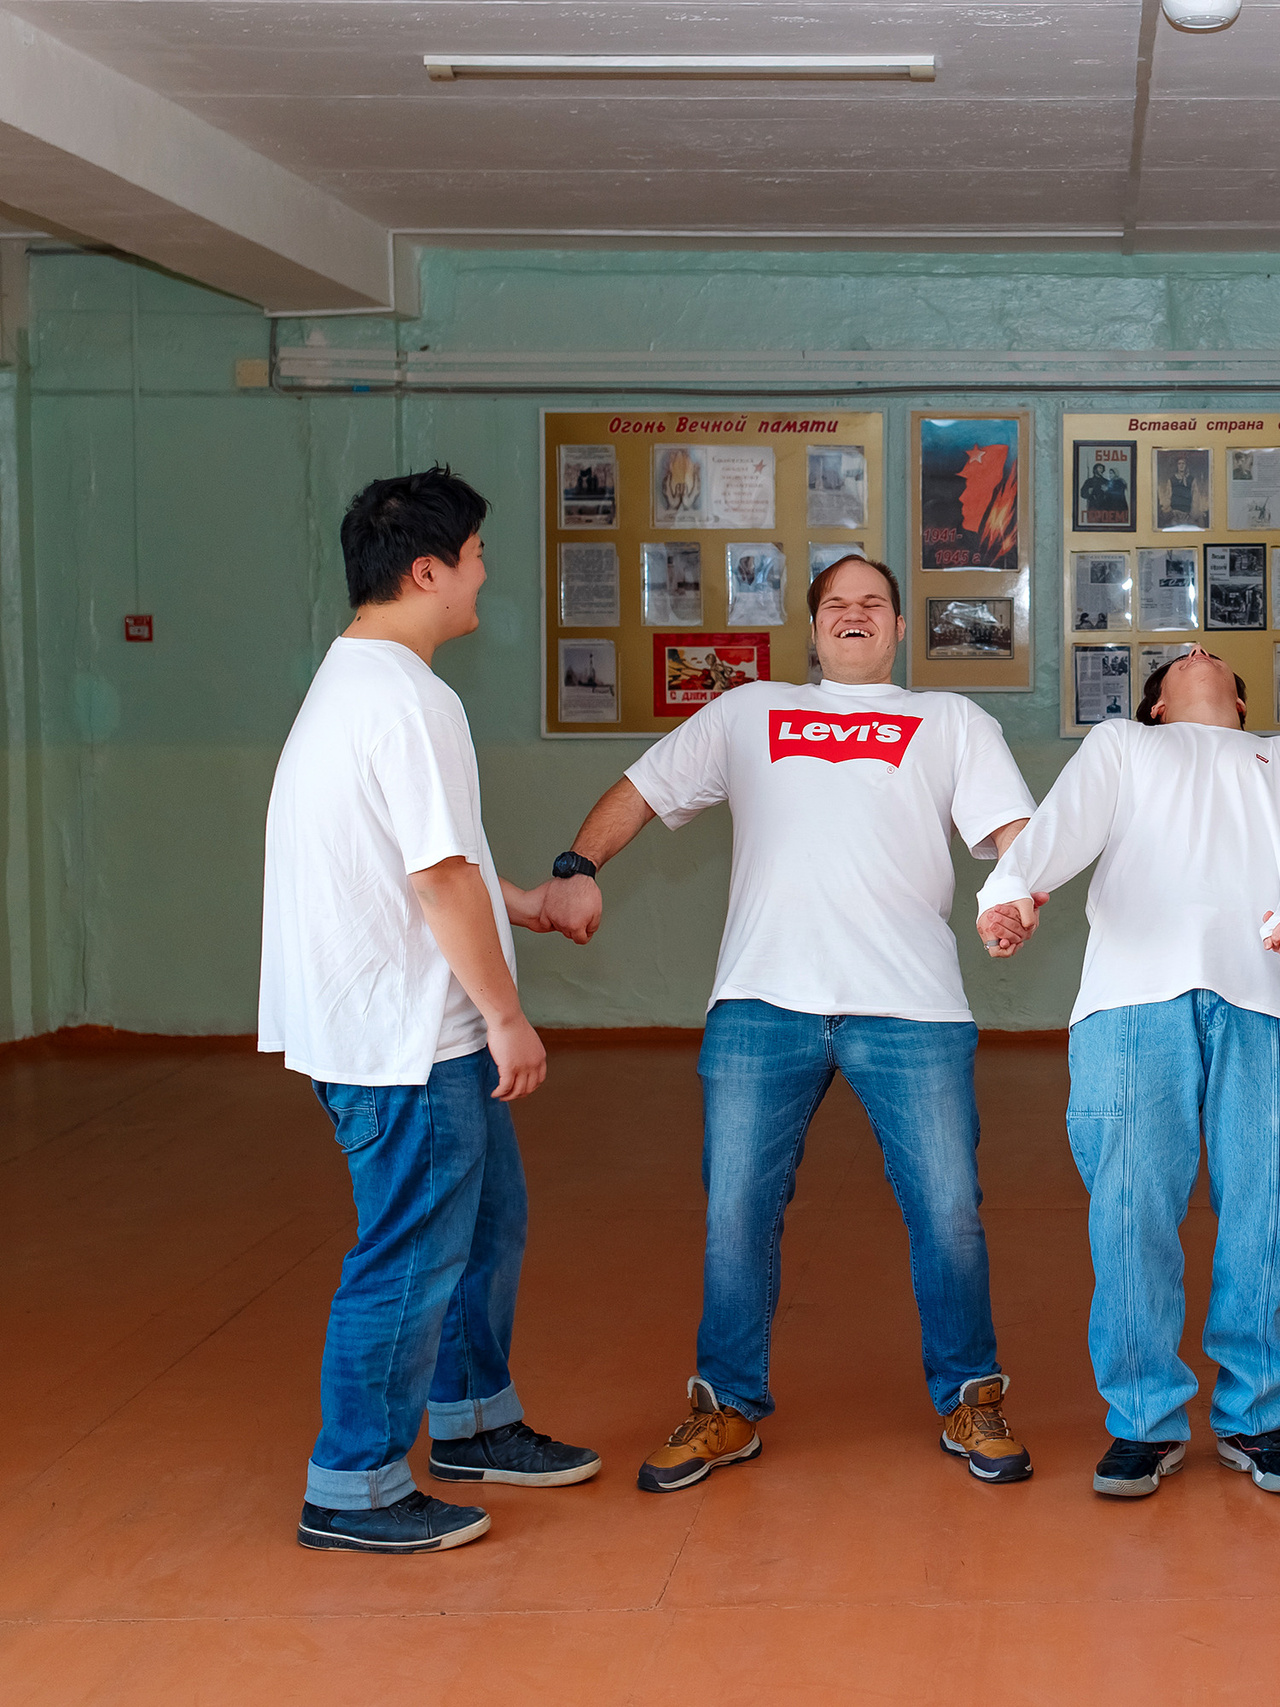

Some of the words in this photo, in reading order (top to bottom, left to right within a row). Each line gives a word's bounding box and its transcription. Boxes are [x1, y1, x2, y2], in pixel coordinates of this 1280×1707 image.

[609, 416, 666, 433] Огонь
[676, 414, 748, 433] Вечной
[758, 419, 839, 433] памяти
[1128, 417, 1197, 431] Вставай
[1206, 420, 1264, 433] страна
[1095, 449, 1128, 462] БУДЬ
[935, 549, 969, 565] 1945
[670, 691, 677, 700] С
